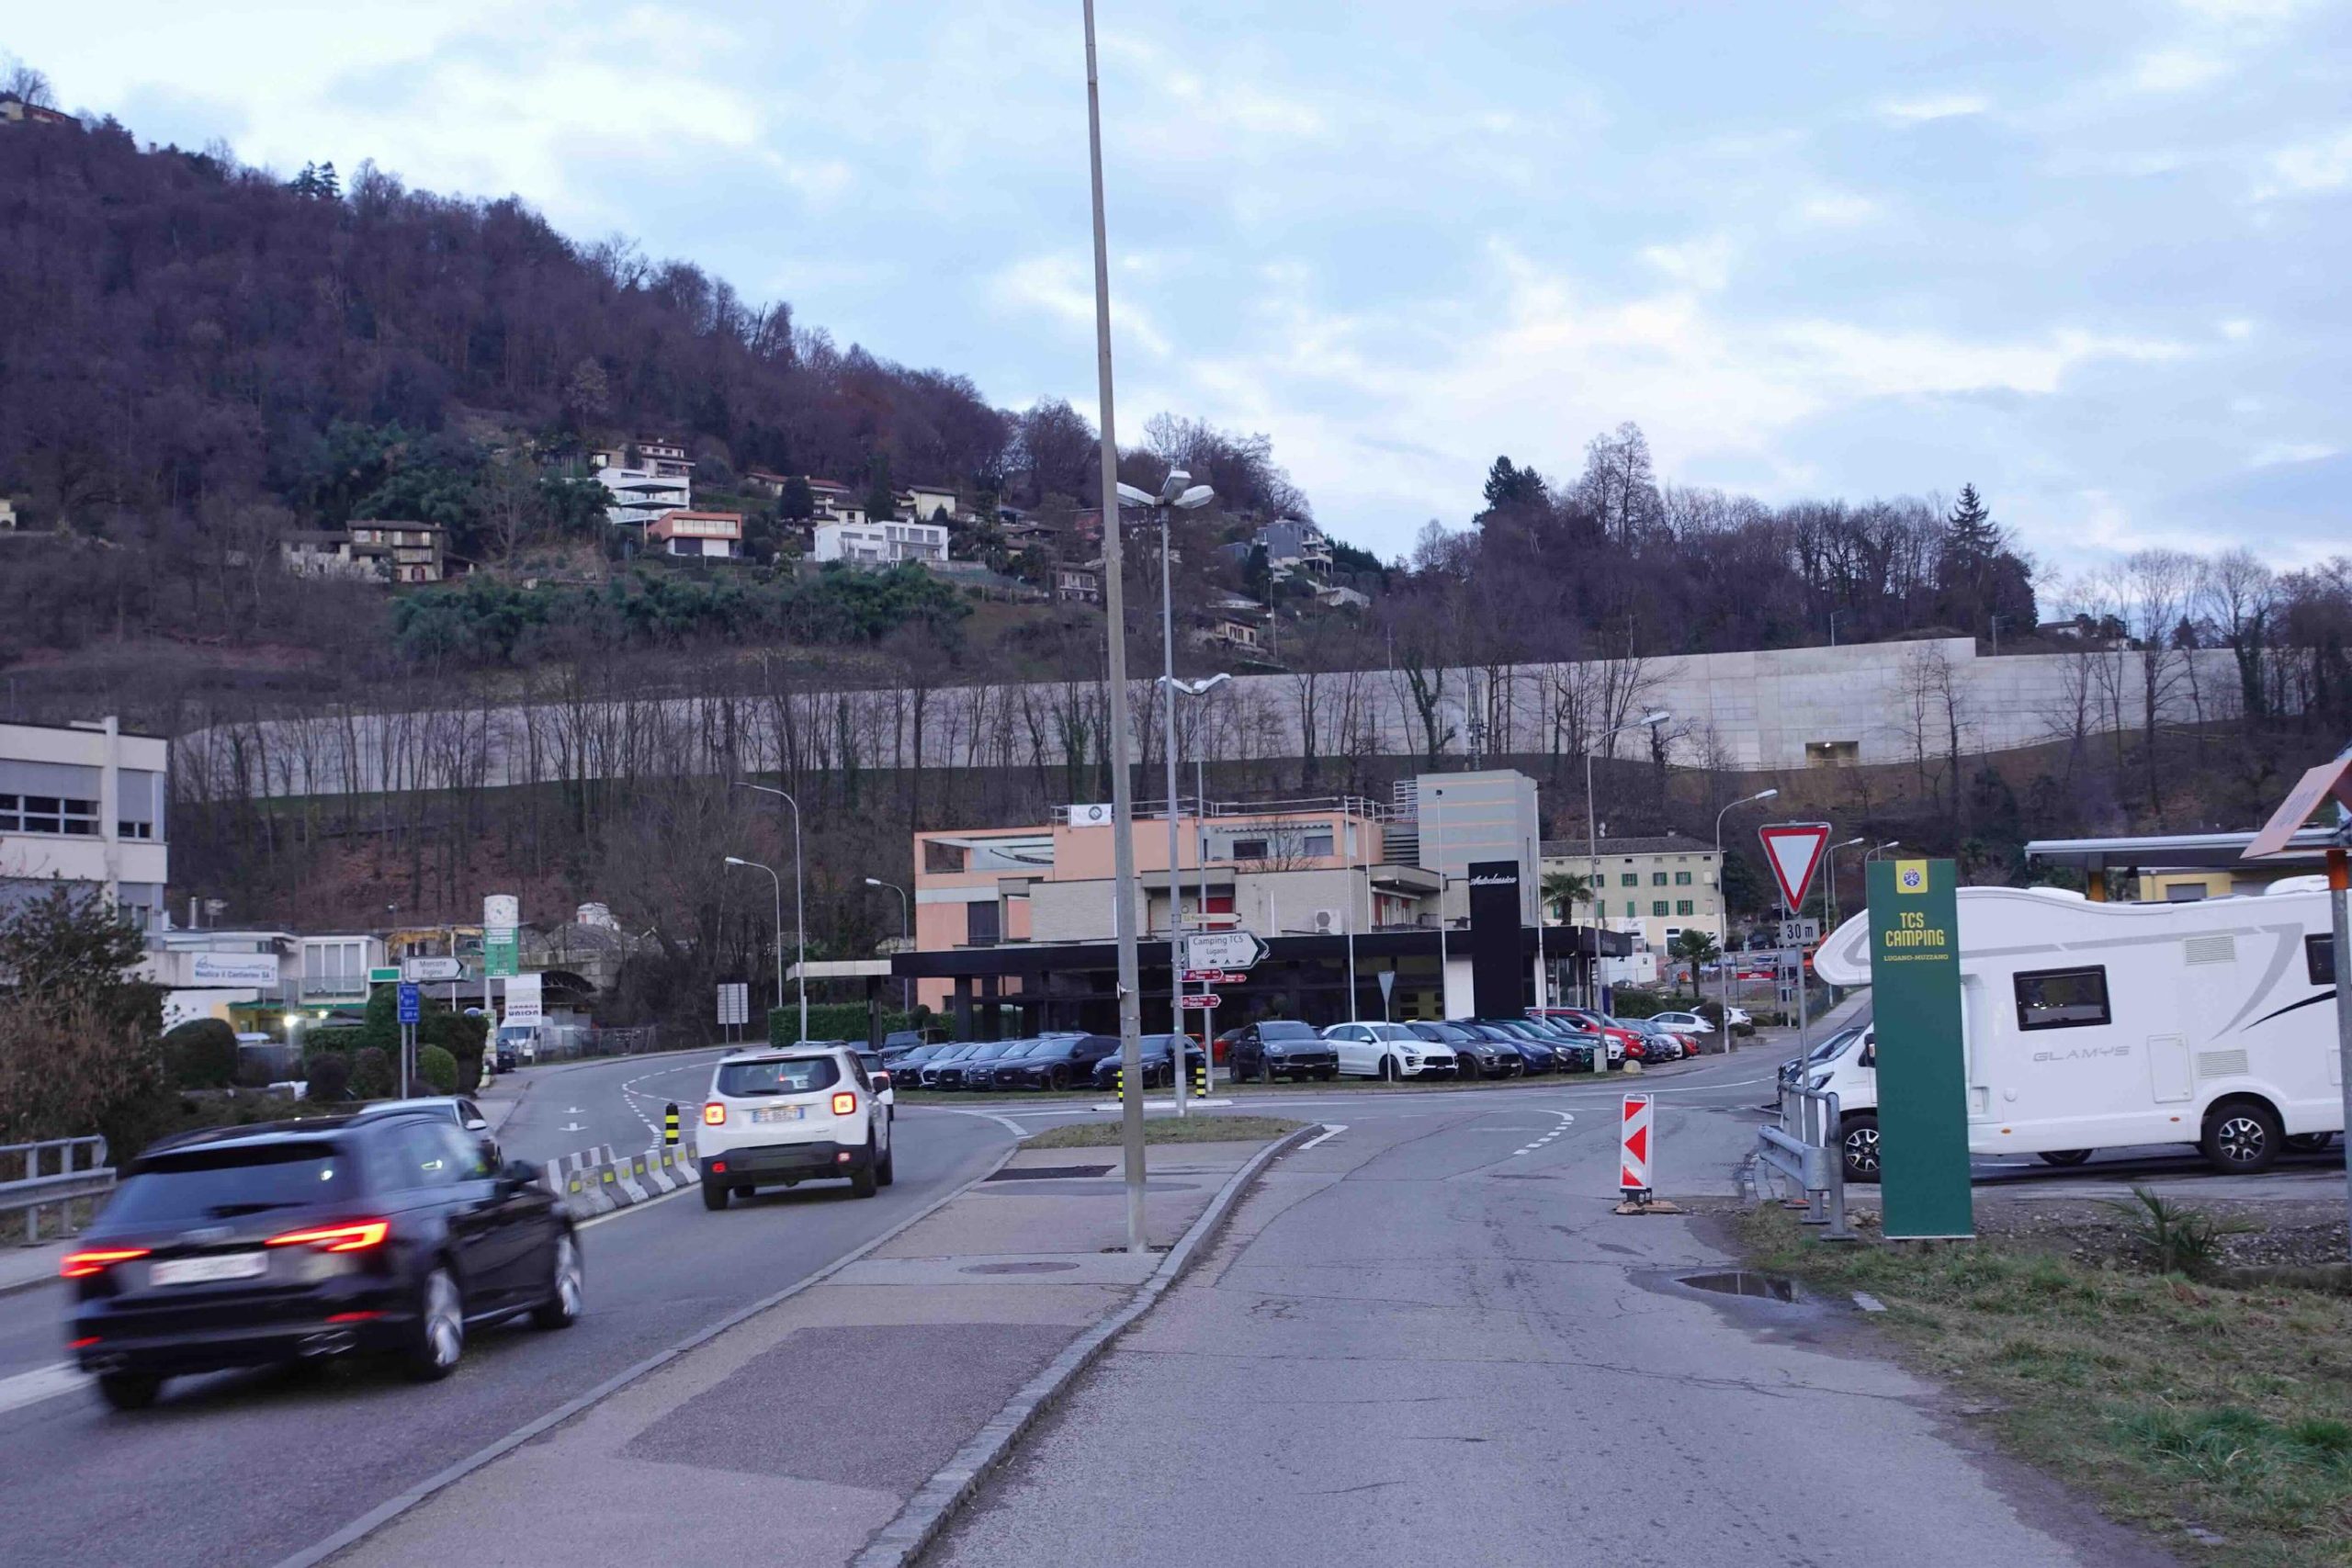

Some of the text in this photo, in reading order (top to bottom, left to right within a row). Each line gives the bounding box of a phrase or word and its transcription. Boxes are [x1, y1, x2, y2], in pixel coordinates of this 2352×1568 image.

[1899, 911, 1925, 929] TCS
[1787, 923, 1814, 939] 30 m
[1885, 929, 1945, 947] CAMPING
[1193, 934, 1243, 946] Camping TCS
[1205, 947, 1227, 956] Lugano
[1883, 953, 1949, 962] LUGANO-MUZZANO
[2033, 1045, 2131, 1062] GLAMYS
